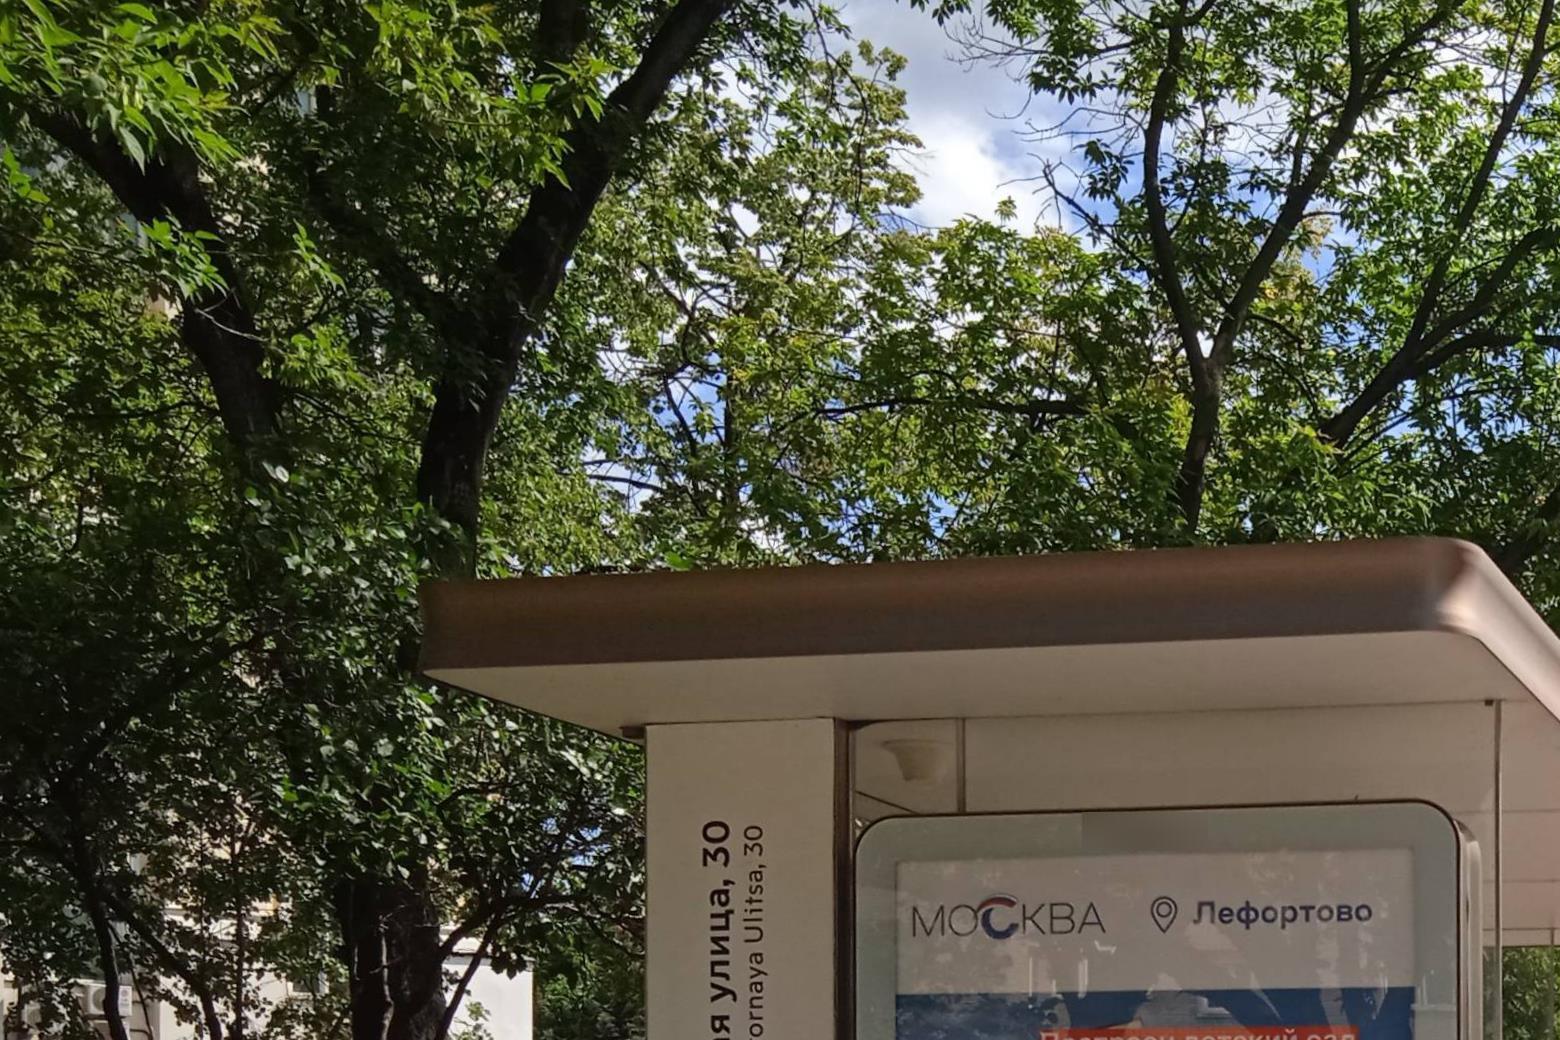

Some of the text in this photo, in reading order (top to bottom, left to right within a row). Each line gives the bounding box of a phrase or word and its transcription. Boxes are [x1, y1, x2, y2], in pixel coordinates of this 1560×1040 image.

[702, 820, 730, 867] 30
[744, 825, 763, 856] 30
[742, 864, 767, 943] Ulitsa,
[911, 894, 1107, 940] МОСКВА
[1193, 900, 1373, 930] Лефортово
[710, 879, 737, 1003] улица,
